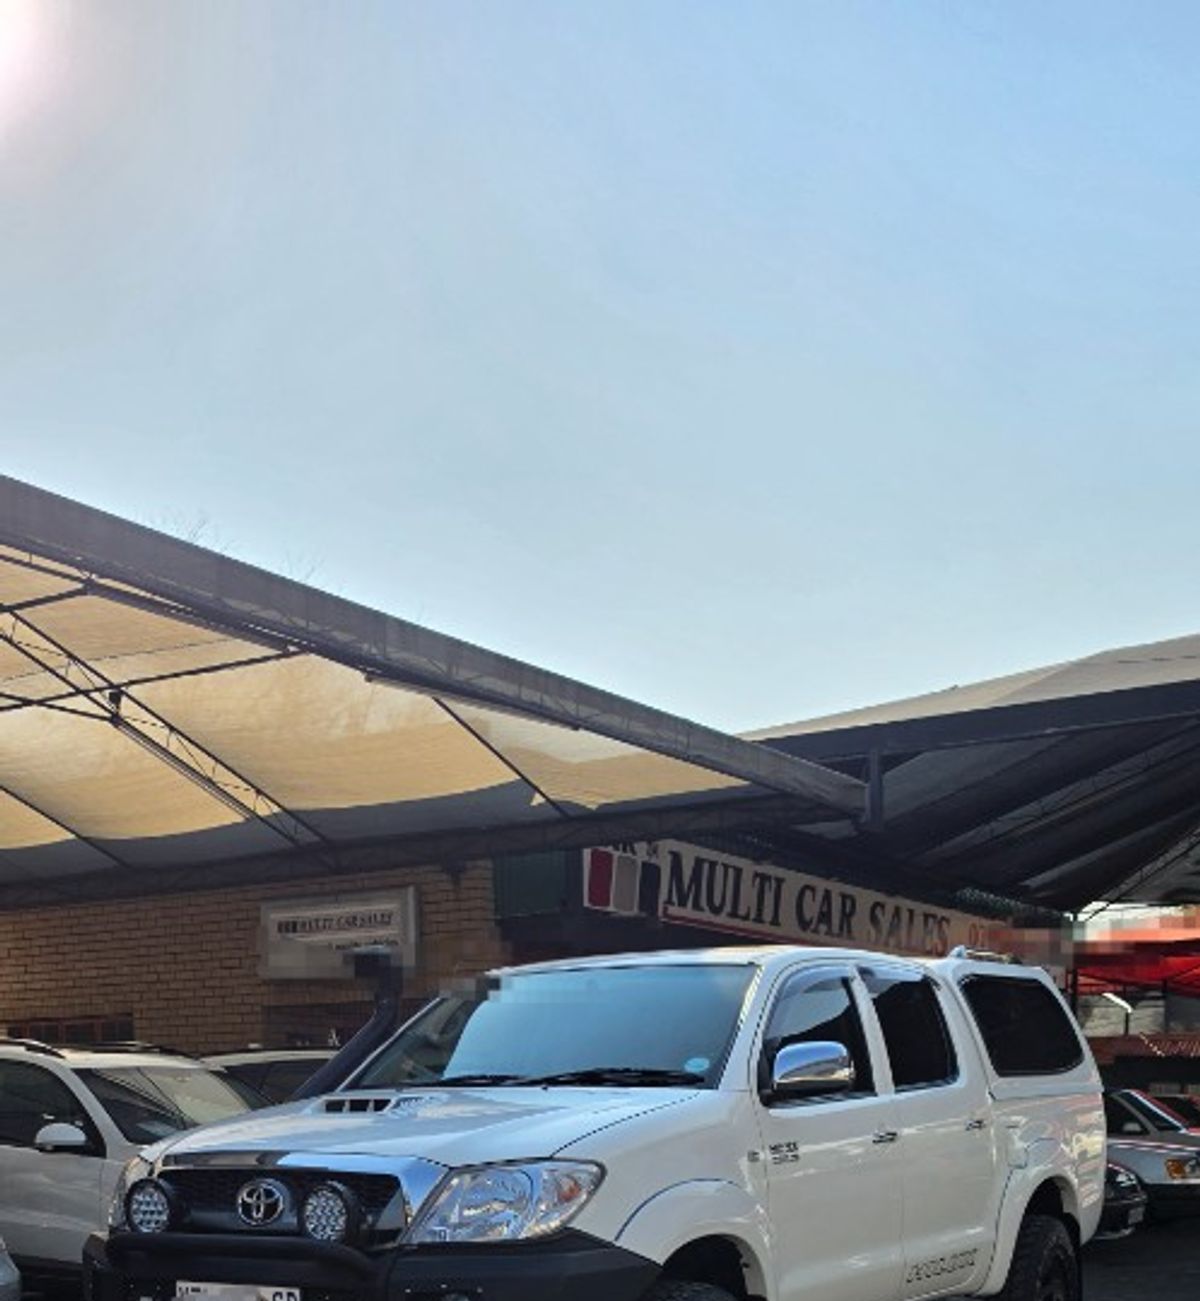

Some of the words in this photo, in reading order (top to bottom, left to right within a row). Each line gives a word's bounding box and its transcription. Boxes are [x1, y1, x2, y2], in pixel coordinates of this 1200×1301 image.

[664, 851, 785, 926] MULTI
[795, 884, 857, 938] CAR
[869, 901, 949, 956] SALES
